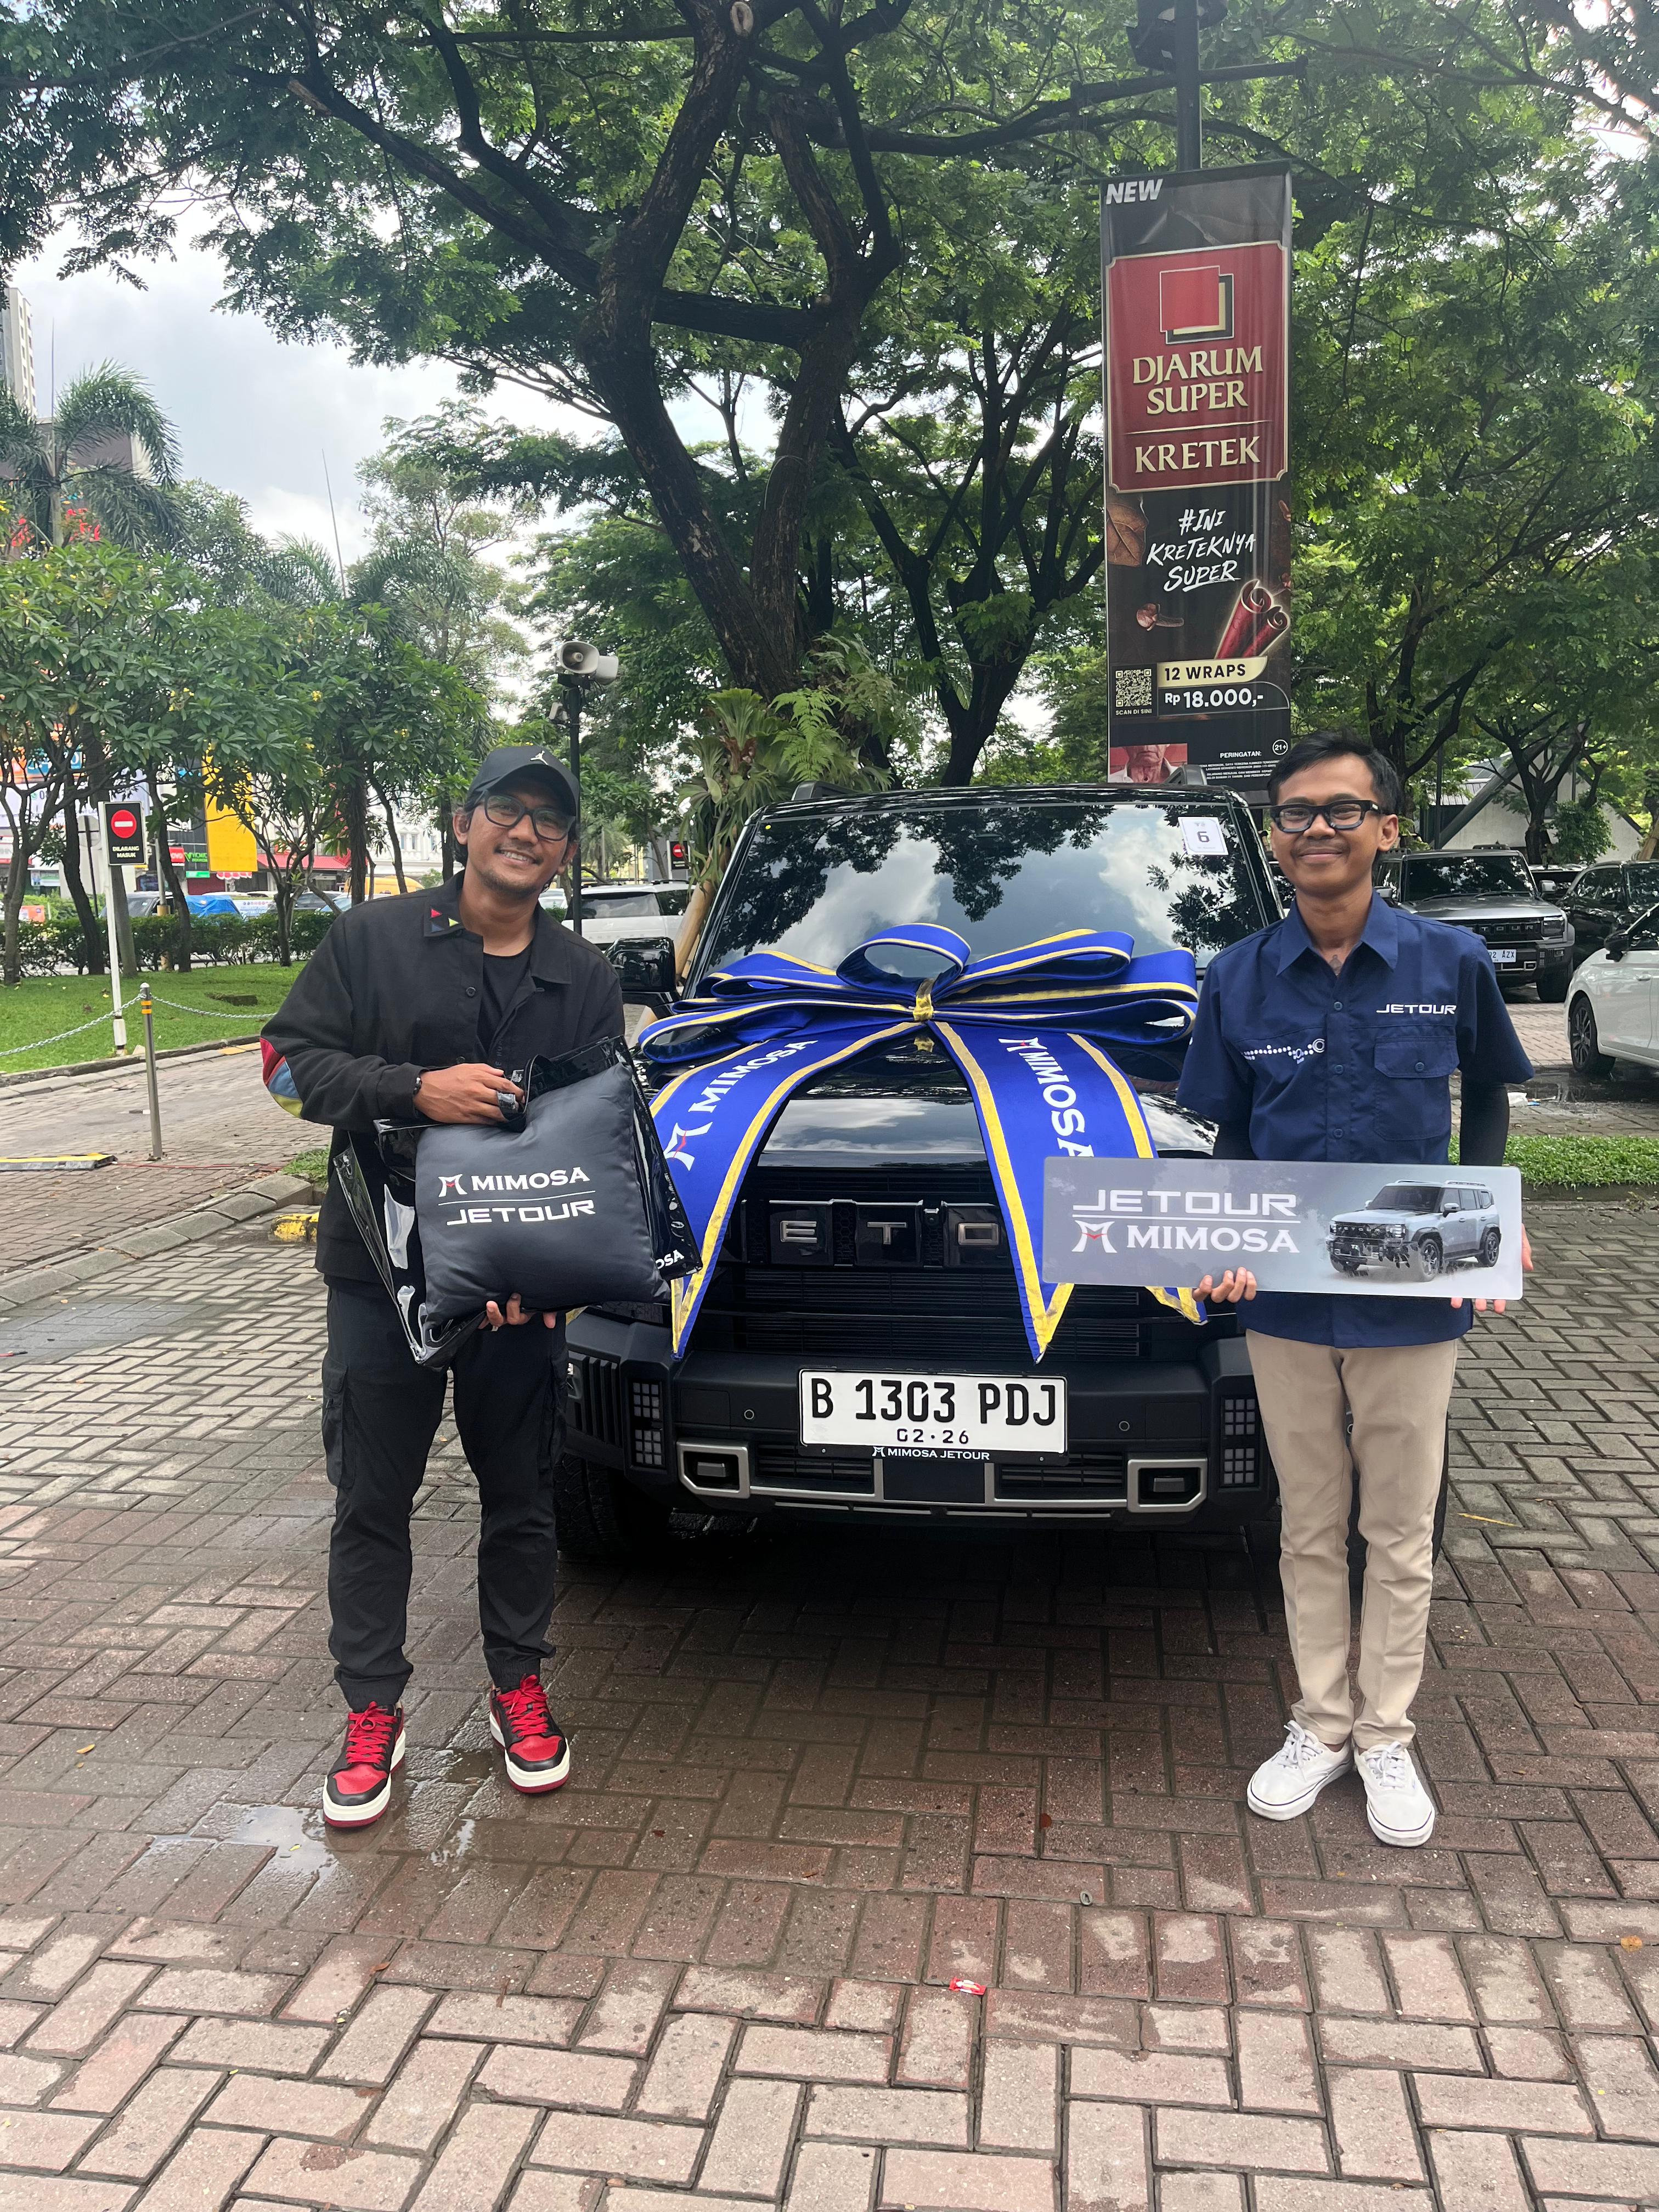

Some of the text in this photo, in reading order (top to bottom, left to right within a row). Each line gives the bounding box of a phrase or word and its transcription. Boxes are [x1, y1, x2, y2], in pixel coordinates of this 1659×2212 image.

[1105, 179, 1164, 205] NEW
[1132, 346, 1263, 385] DJARUM
[1147, 380, 1248, 415] SUPER
[1135, 436, 1261, 474] KRETEK
[1178, 509, 1226, 535] #INI
[1146, 531, 1256, 566] KRETEKNYA
[1163, 560, 1238, 592] SUPER
[1164, 663, 1246, 681] 12 WRAPS
[1165, 687, 1263, 708] Rp 18.000,-
[1220, 751, 1262, 759] PERINGATAN:
[1197, 831, 1210, 843] 6
[1502, 950, 1515, 958] AZX
[1376, 1003, 1457, 1015] JETOUR
[688, 1040, 819, 1113] MIMOSA
[471, 1167, 590, 1192] MIMOSA
[447, 1200, 596, 1226] JETOUR
[1073, 1189, 1297, 1216] JETOUR
[1126, 1224, 1300, 1254] MIMOSA
[811, 1378, 1056, 1426] B 1303 PDJ
[888, 1448, 990, 1460] MIMOSA JETOUR
